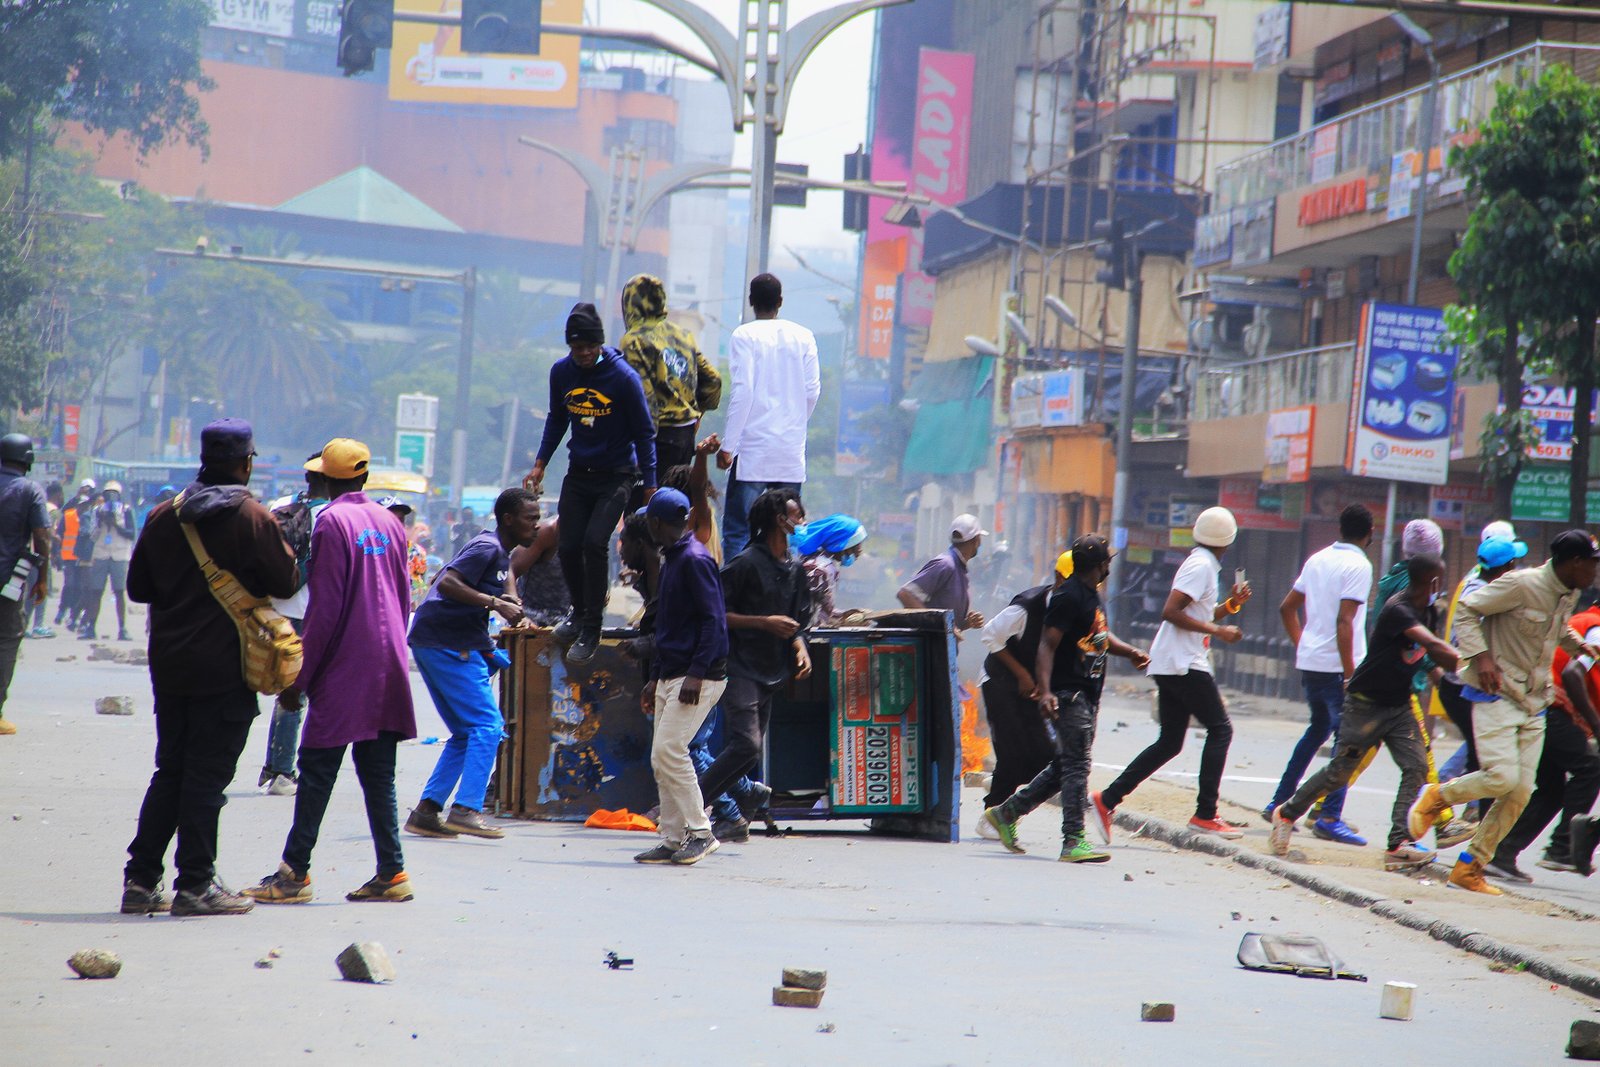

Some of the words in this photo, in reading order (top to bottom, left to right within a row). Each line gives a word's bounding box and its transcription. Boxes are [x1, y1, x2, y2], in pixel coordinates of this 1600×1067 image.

[1415, 315, 1436, 329] STOP
[1391, 445, 1435, 459] RIKKO
[868, 727, 888, 804] 2039603
[892, 735, 900, 774] AGENT
